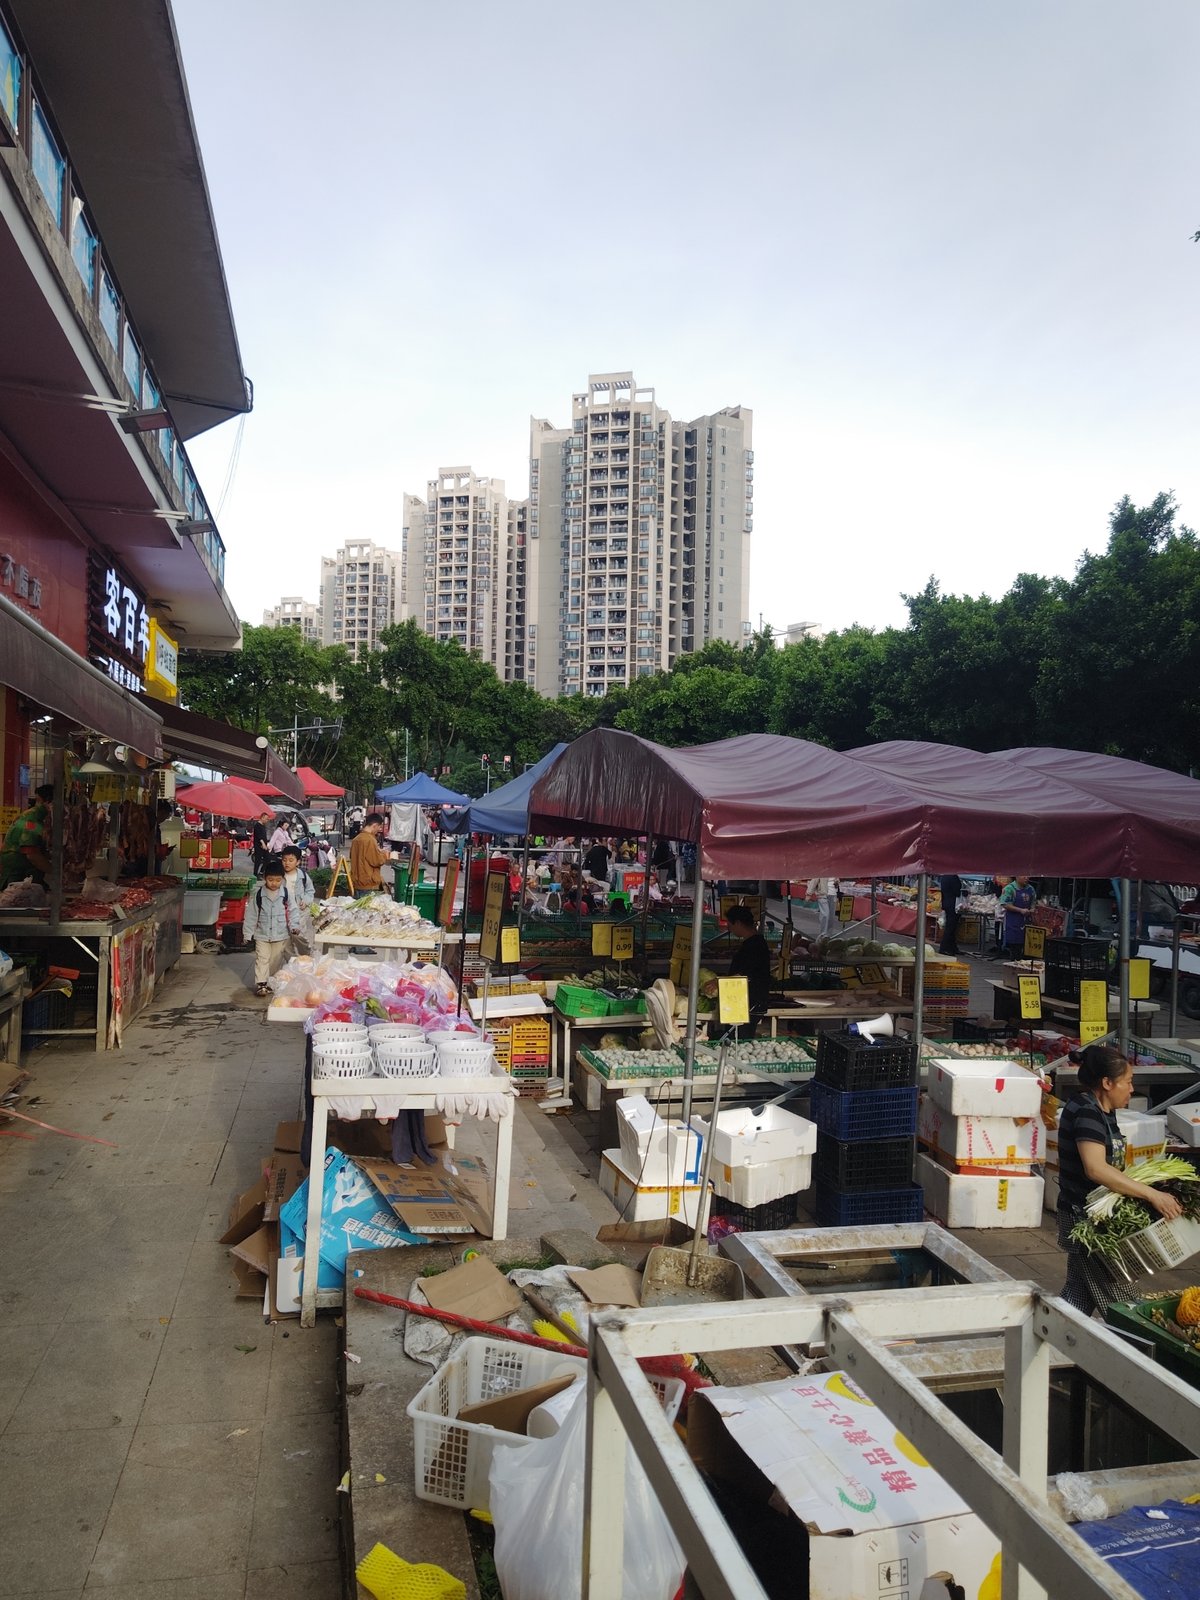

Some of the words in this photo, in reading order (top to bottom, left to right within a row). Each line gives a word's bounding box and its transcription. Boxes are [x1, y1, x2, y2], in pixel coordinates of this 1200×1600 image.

[104, 568, 150, 663] 客百年
[616, 943, 632, 951] 0.99
[1025, 1000, 1040, 1009] 5.58
[792, 1385, 917, 1493] 精品黄心土豆
